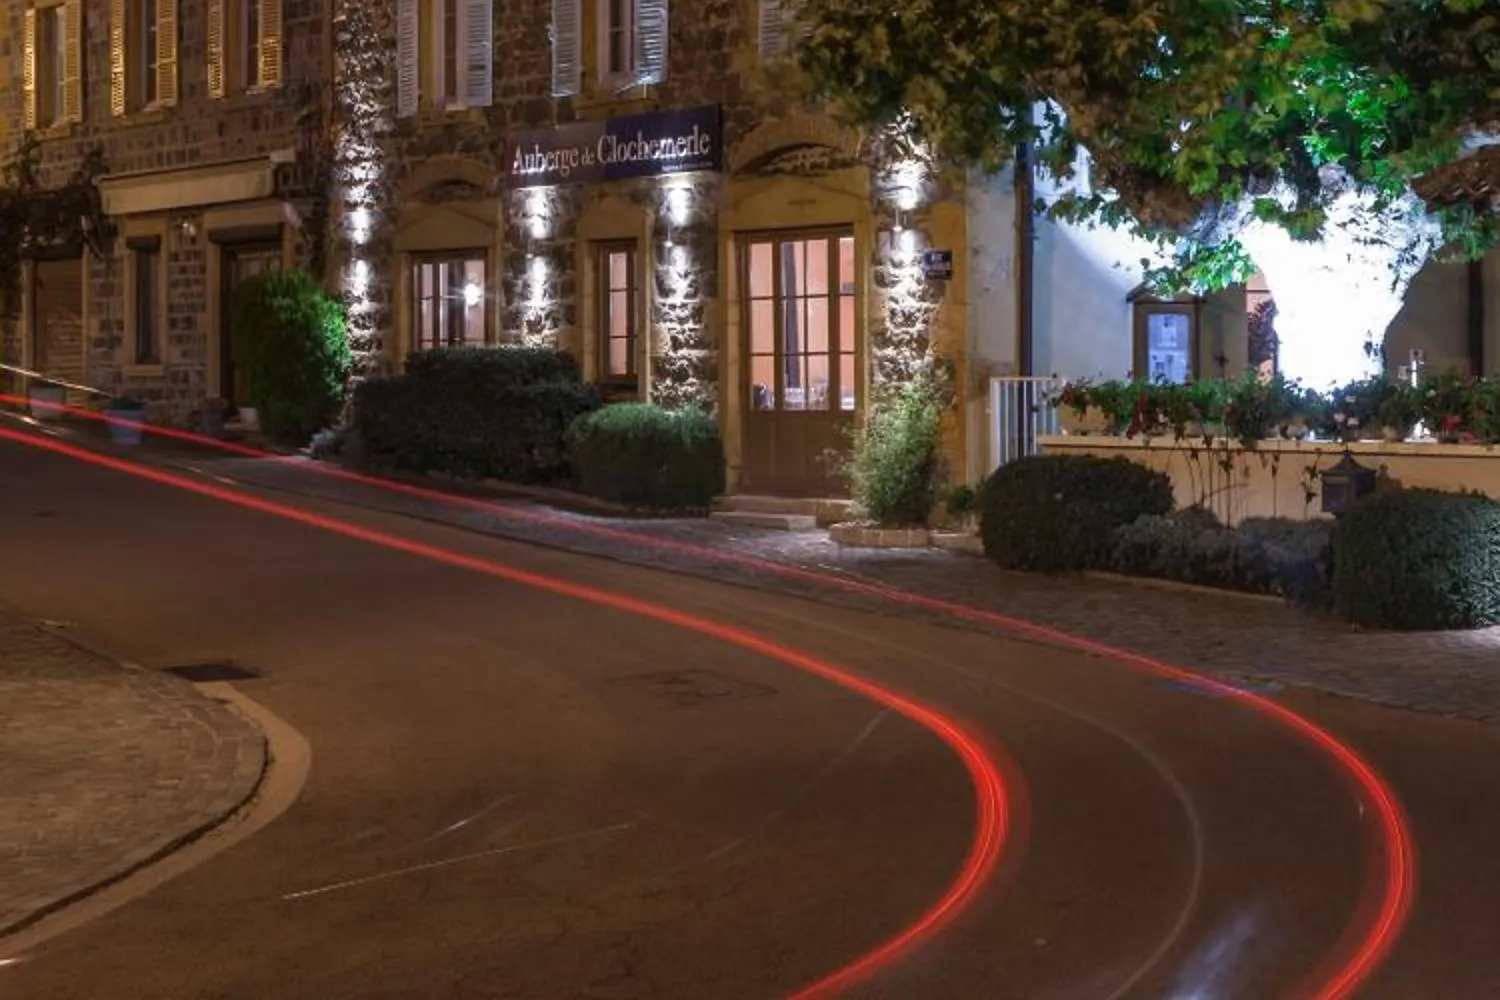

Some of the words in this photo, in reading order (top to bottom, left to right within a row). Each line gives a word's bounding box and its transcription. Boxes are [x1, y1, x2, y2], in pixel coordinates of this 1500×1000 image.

[511, 143, 579, 177] Auberge
[582, 147, 596, 165] de
[597, 124, 711, 165] Clochemerle
